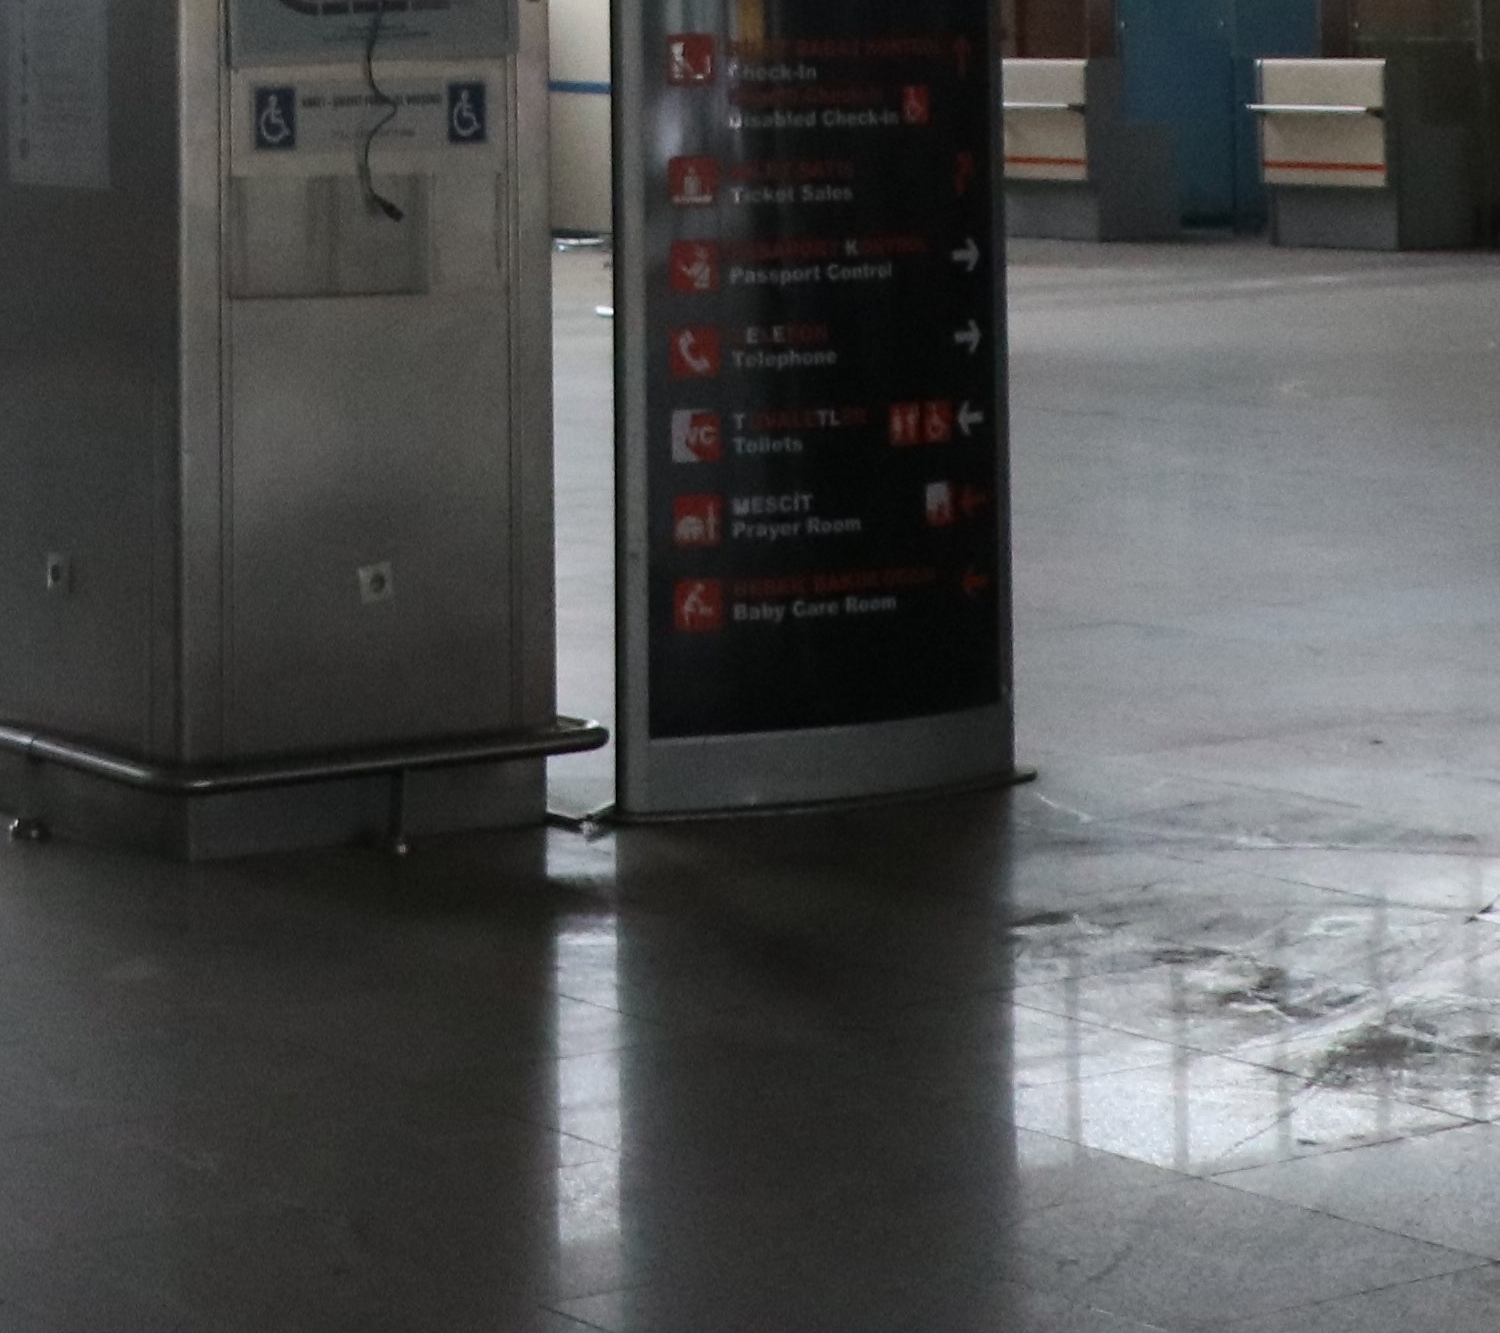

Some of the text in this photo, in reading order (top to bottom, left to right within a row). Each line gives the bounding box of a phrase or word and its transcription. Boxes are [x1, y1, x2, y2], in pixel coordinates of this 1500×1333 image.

[727, 112, 817, 130] Disabled
[729, 184, 855, 204] Ticket Sales
[729, 262, 893, 286] Passport Control
[731, 349, 838, 370] Telephone
[732, 436, 804, 455] Toilets
[732, 493, 814, 516] MESCİT
[732, 515, 862, 543] Prayer Room
[732, 595, 898, 625] Baby Care Room
